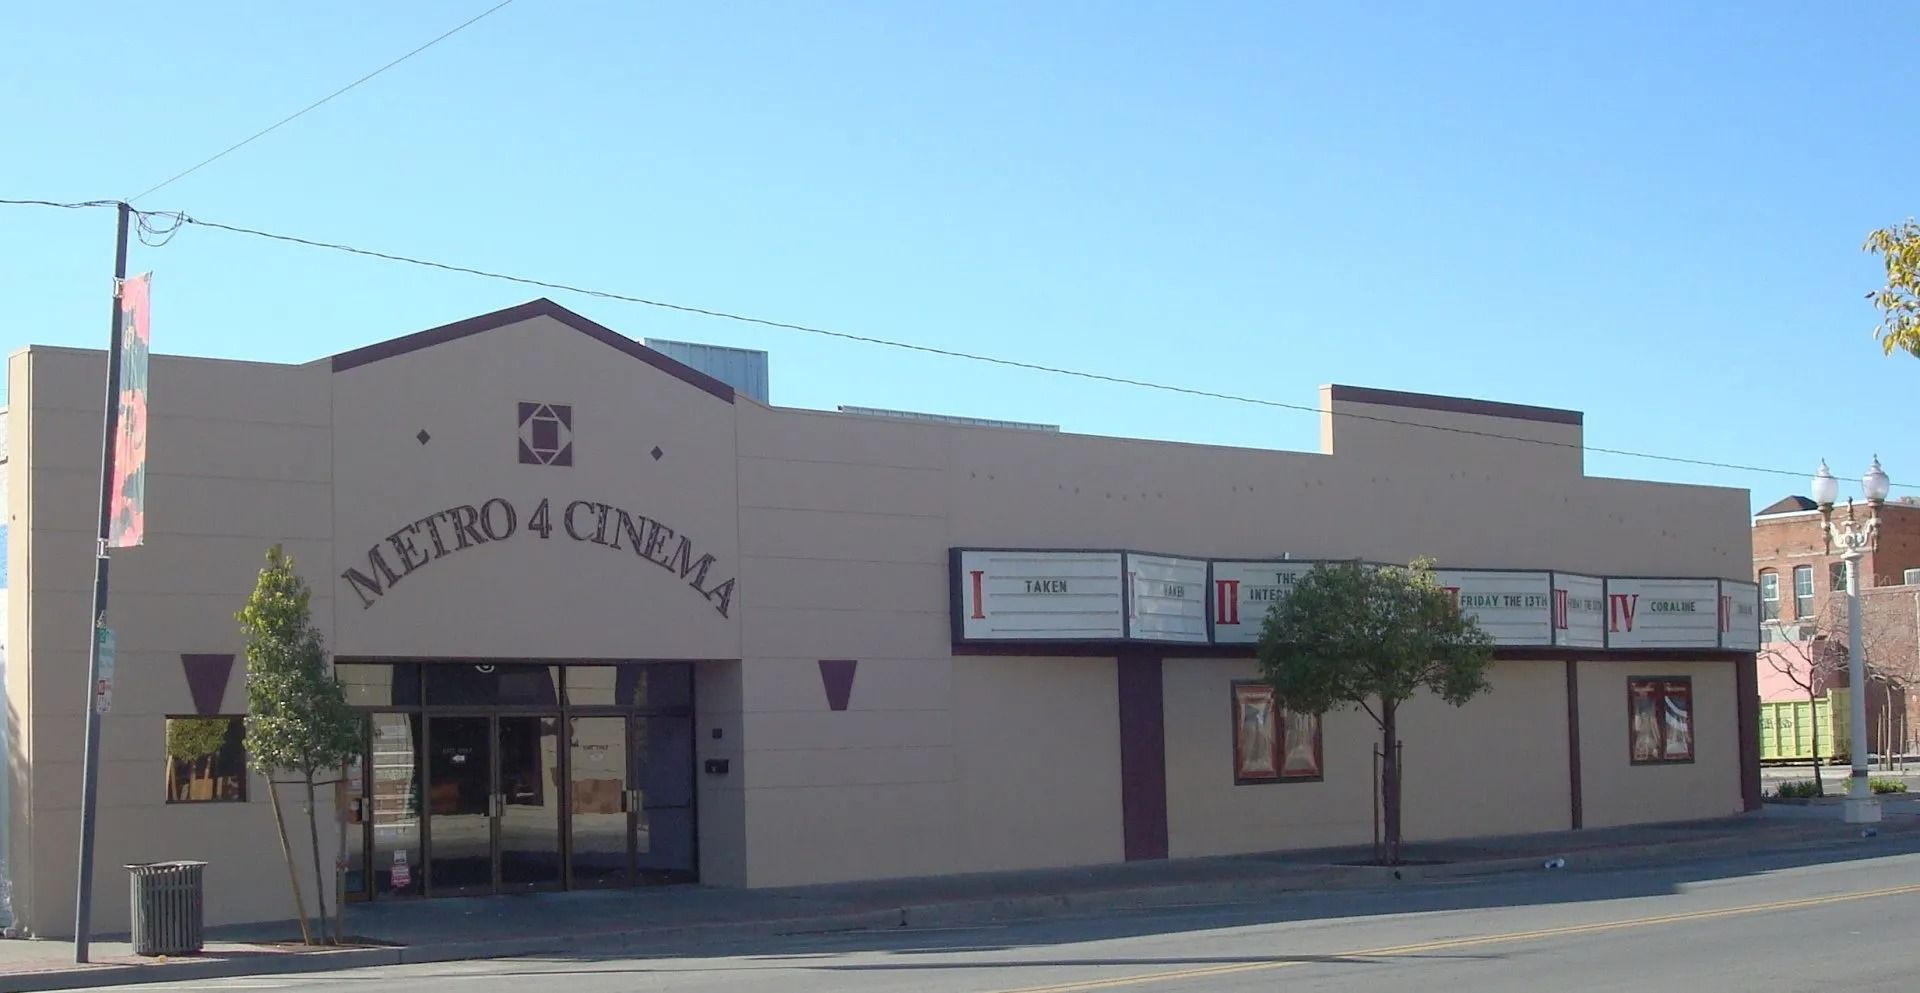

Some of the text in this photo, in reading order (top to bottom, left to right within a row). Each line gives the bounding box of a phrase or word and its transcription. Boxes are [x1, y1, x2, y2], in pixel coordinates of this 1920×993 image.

[341, 498, 736, 618] METRO 4 CINEMA
[1025, 580, 1068, 593] TAKEN
[1276, 573, 1297, 584] THE
[970, 571, 985, 619] I
[1215, 580, 1240, 624] II
[1461, 595, 1548, 607] FRIDAY THE 13TH
[1651, 601, 1696, 612] CORALINE
[1609, 594, 1639, 632] IV
